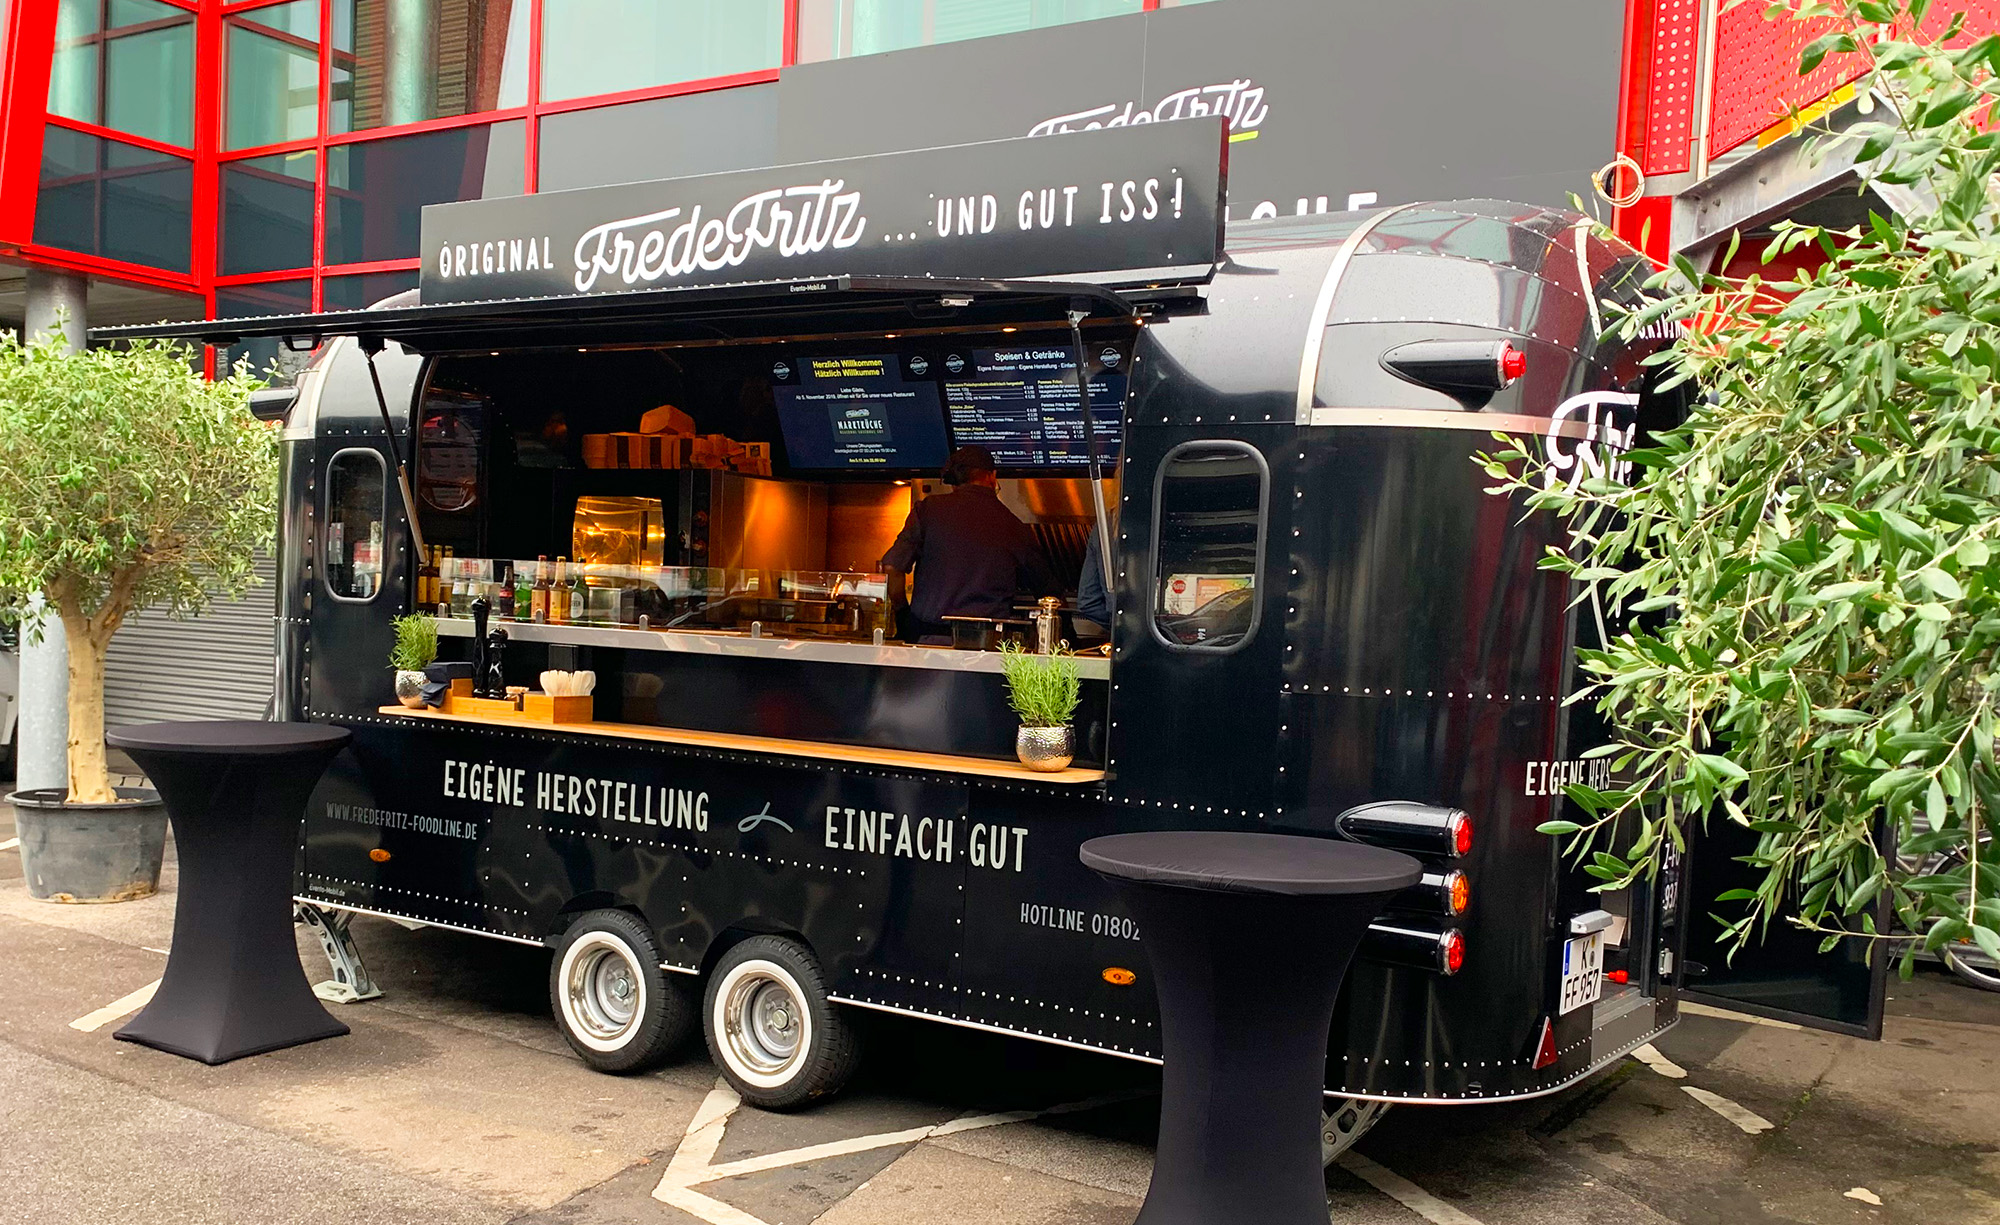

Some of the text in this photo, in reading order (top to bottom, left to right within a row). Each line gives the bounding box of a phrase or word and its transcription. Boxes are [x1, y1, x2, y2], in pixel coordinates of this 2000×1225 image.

[440, 237, 554, 279] ORIGINAL
[574, 178, 867, 292] FredeFritz
[937, 194, 998, 238] UND
[1017, 185, 1079, 231] GUT
[812, 359, 883, 369] Herzlich Willkommen
[994, 352, 1023, 362] Speisen
[1032, 350, 1066, 360] Getränke
[443, 759, 710, 833] EIGENE HERSTELLUNG
[1525, 761, 1586, 796] EIGENE
[326, 802, 478, 841] WWW.FREDEFRITZ-FOODLINE.DE
[825, 806, 1029, 873] EINFACH GUT
[1020, 902, 1085, 932] HOTLINE
[1581, 939, 1590, 971] K
[1563, 968, 1600, 1009] FF 957
